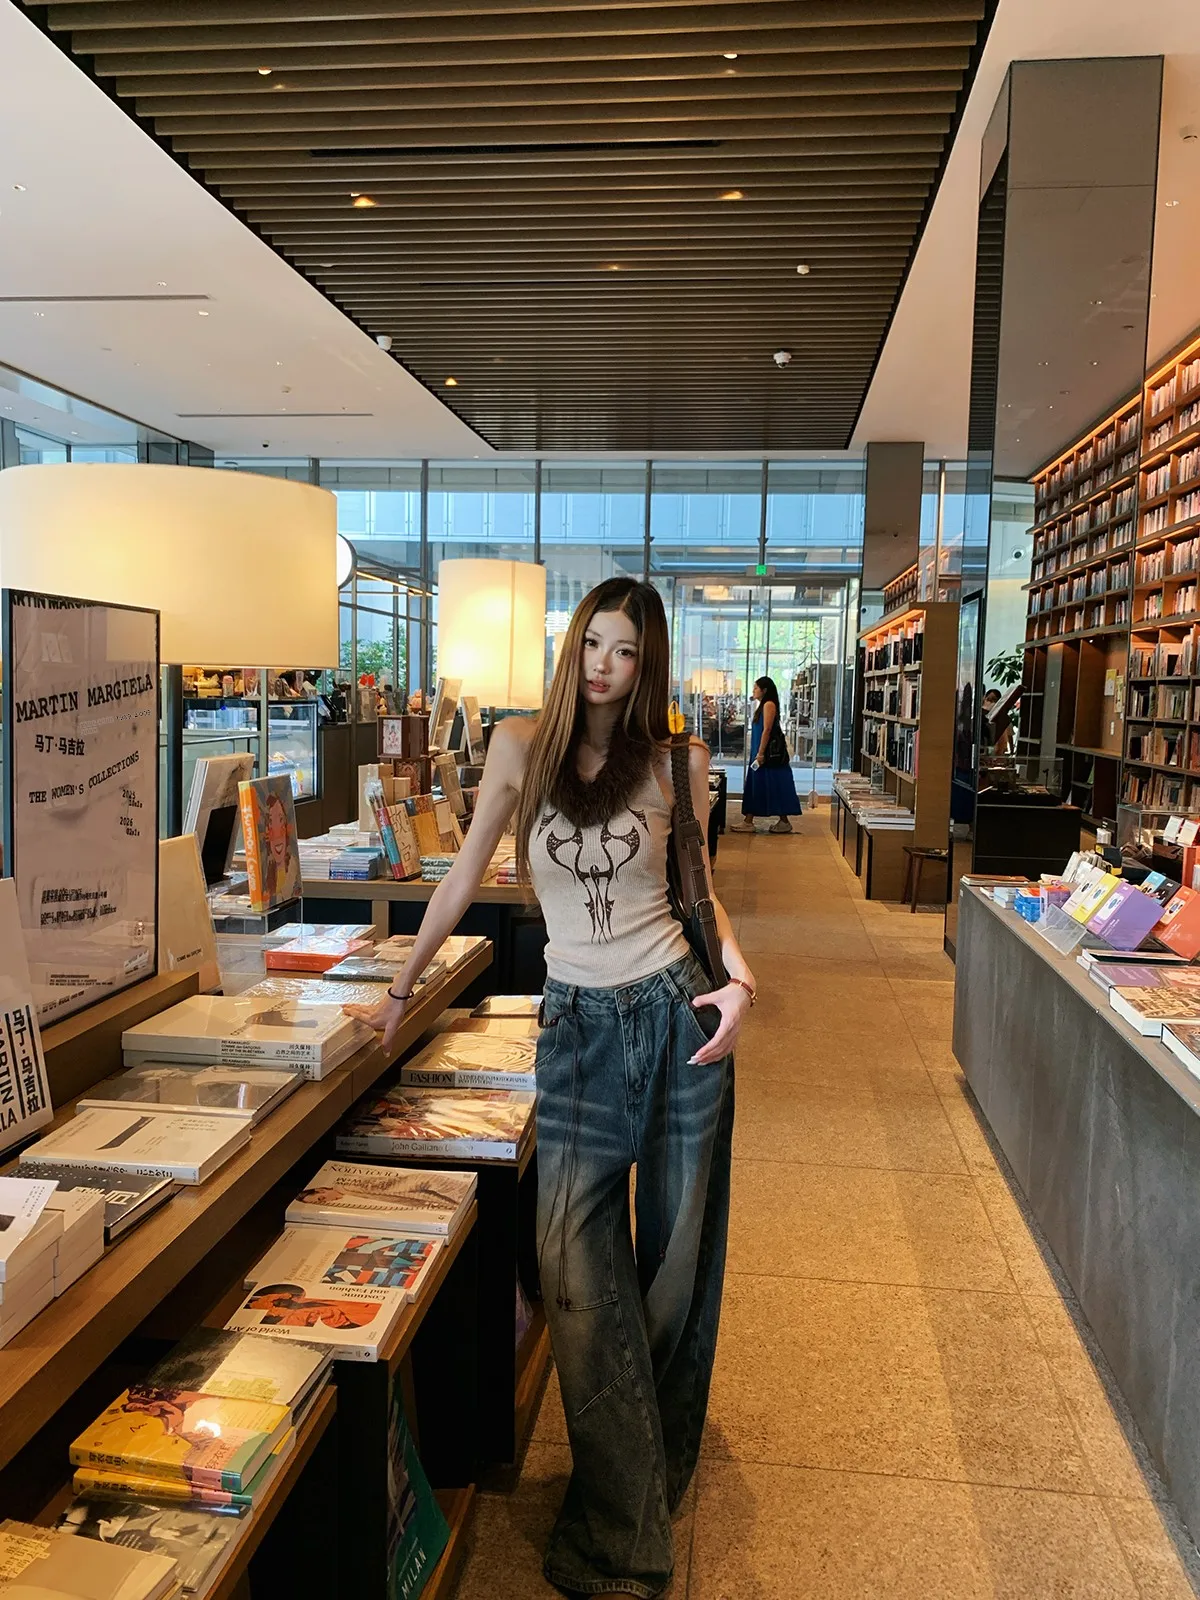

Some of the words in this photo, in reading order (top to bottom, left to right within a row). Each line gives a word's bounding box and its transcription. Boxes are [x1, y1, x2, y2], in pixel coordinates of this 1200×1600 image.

[16, 690, 79, 723] MARTIN
[87, 673, 153, 708] MARGIELA
[34, 734, 85, 756] 马丁·马吉拉
[28, 791, 47, 804] THE
[51, 783, 85, 801] WOMEN'S
[88, 750, 140, 789] COLLECTIONS
[122, 789, 136, 800] 2025
[119, 816, 133, 827] 2026
[12, 1008, 41, 1116] 马丁·马吉拉
[410, 1071, 453, 1084] FASHION
[391, 1141, 409, 1151] John
[257, 1327, 290, 1335] World
[401, 1547, 427, 1600] MILAN
